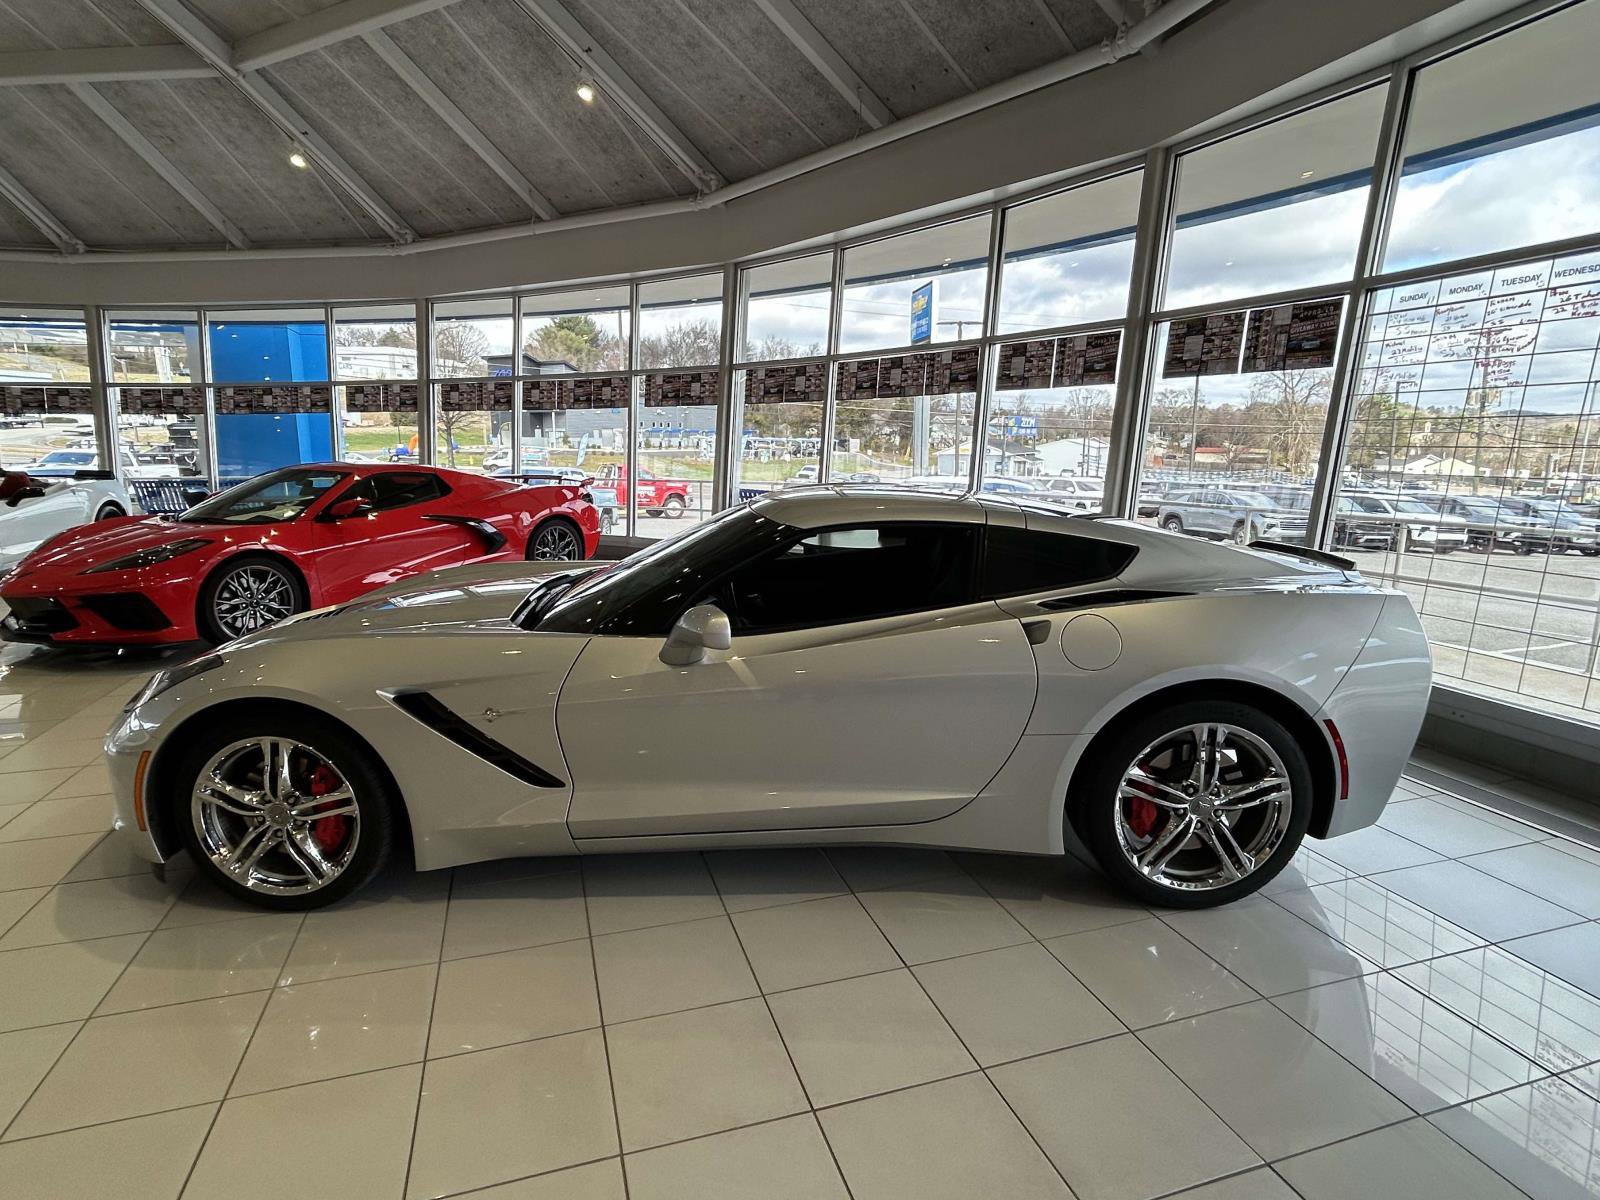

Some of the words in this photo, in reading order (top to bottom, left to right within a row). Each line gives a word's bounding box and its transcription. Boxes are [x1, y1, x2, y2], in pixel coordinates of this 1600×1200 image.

[1501, 273, 1543, 287] TUESDAY
[1449, 283, 1484, 296] MONDAY
[1400, 292, 1429, 303] SUNDAY
